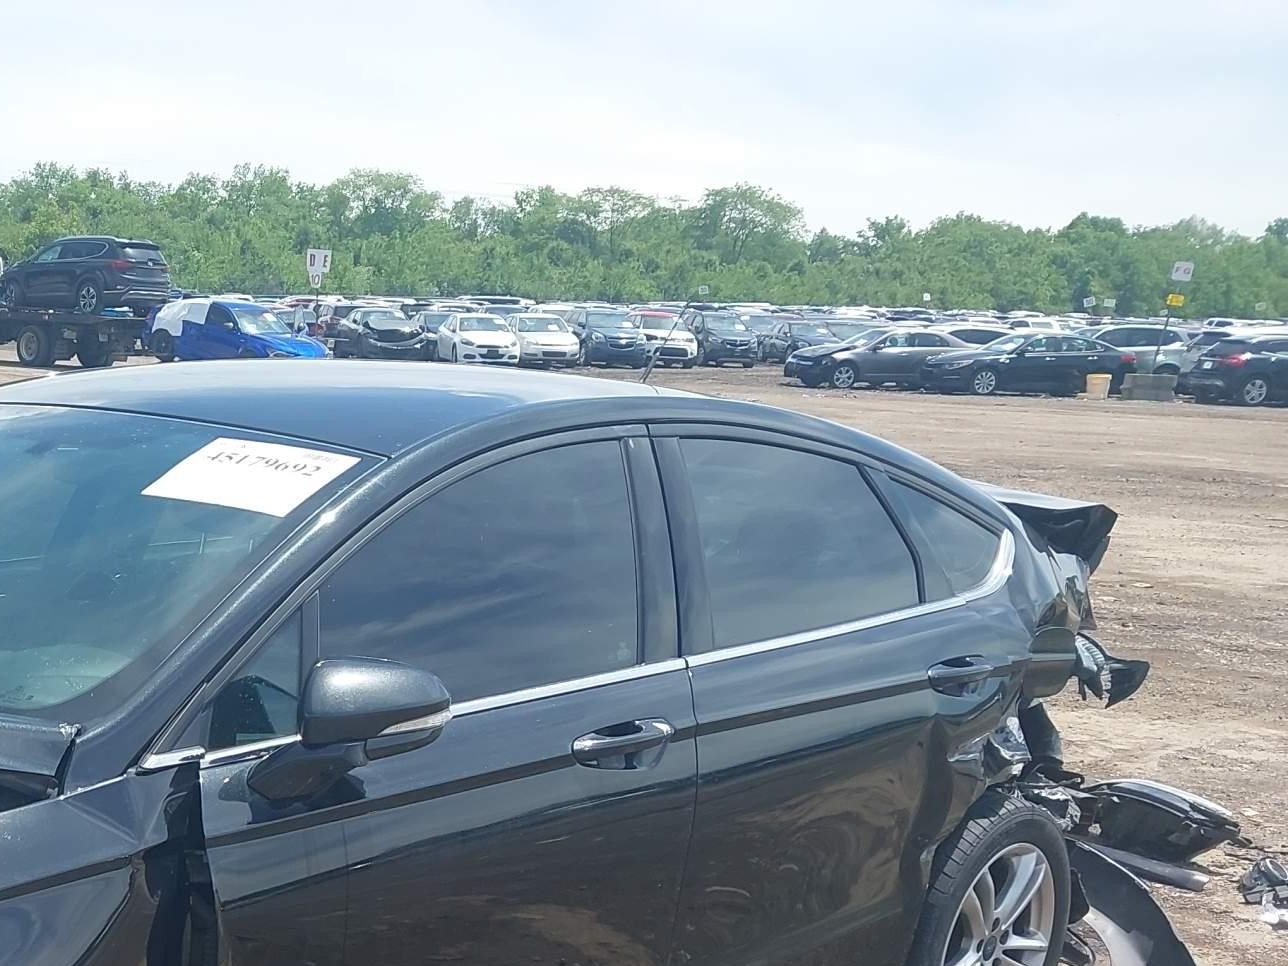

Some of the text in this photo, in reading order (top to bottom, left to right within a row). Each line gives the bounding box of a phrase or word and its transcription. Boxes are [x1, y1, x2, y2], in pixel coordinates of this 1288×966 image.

[310, 254, 328, 267] D E
[312, 274, 320, 285] 10
[207, 451, 322, 476] 45179692
